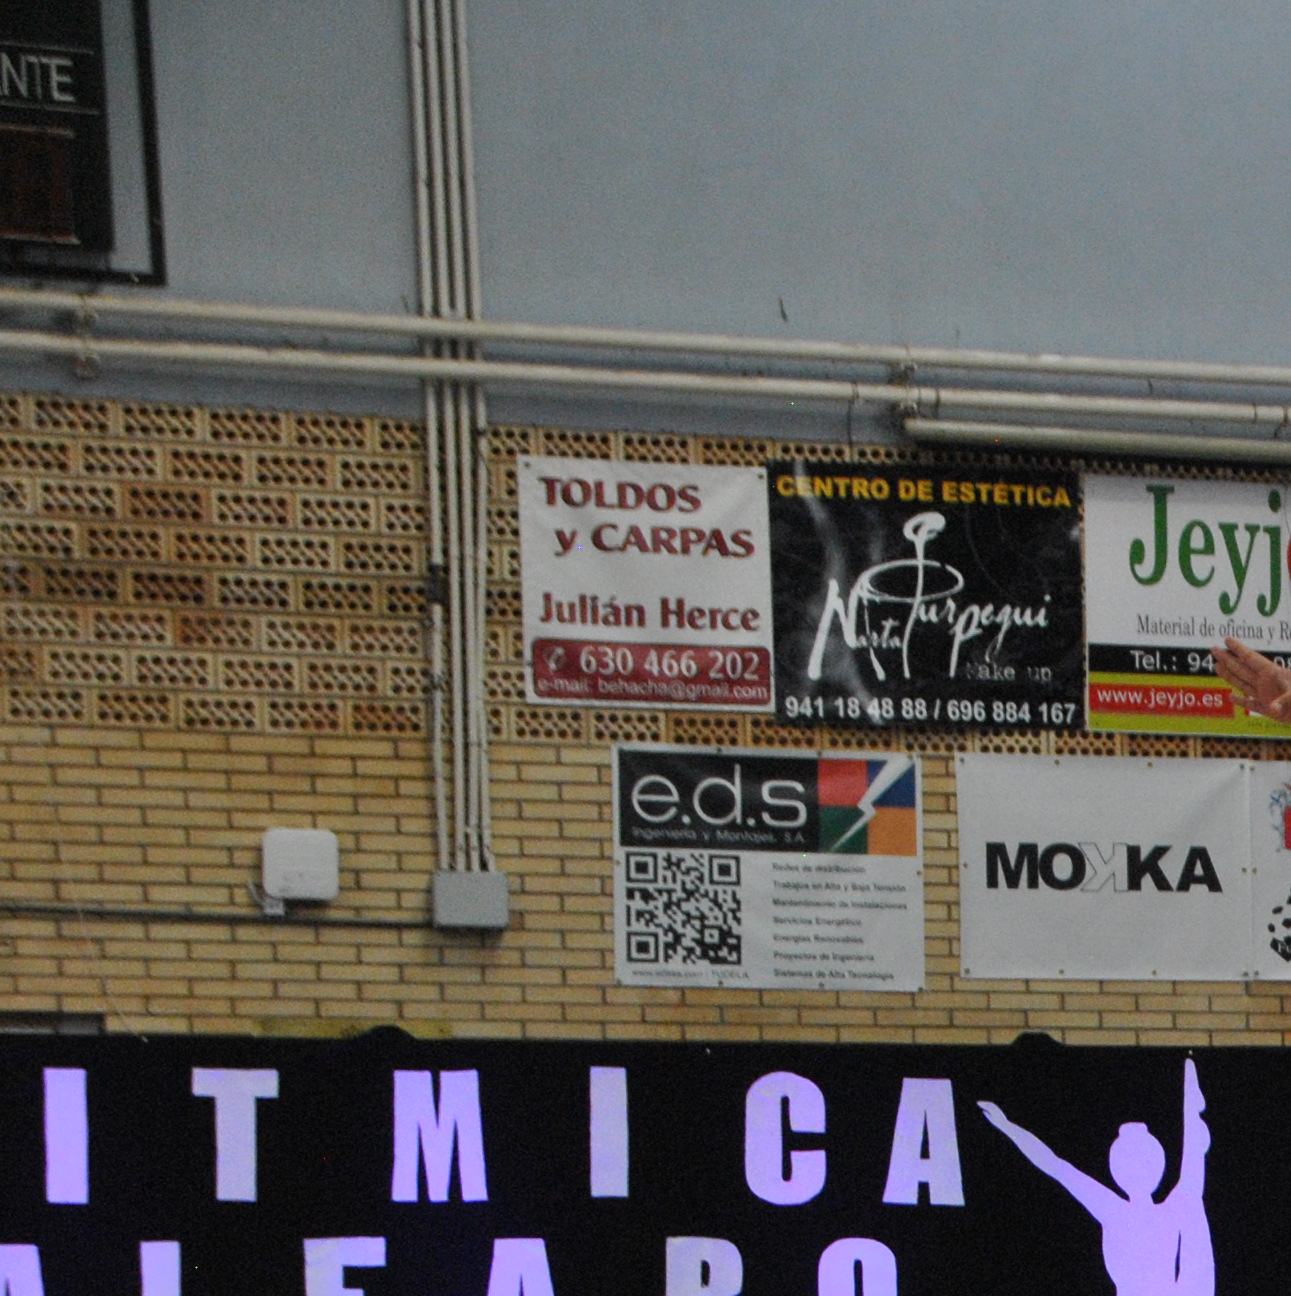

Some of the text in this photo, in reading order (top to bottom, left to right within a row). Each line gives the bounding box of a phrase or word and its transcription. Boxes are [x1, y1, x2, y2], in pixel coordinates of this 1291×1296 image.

[0, 52, 76, 102] NTE
[537, 476, 702, 513] TOLDOS
[777, 475, 1071, 508] CENTRO DE ESTETICA
[555, 523, 755, 557] y CARPAS
[539, 592, 760, 631] Julián Herce
[1137, 614, 1195, 637] Material
[1199, 619, 1215, 637] de
[1218, 618, 1264, 640] oficina
[1267, 626, 1275, 642] y
[579, 646, 760, 681] 630 466 202
[1130, 650, 1177, 671] Tel.:
[1187, 653, 1217, 673] 94
[785, 696, 824, 719] 941
[834, 697, 860, 719] 18
[866, 698, 894, 721] 48
[901, 699, 927, 720] 88
[947, 700, 986, 722] 696
[992, 702, 1030, 723] 884
[1038, 702, 1076, 724] 167
[1097, 688, 1223, 709] www.jeyjo.es
[632, 764, 807, 828] e.d.s
